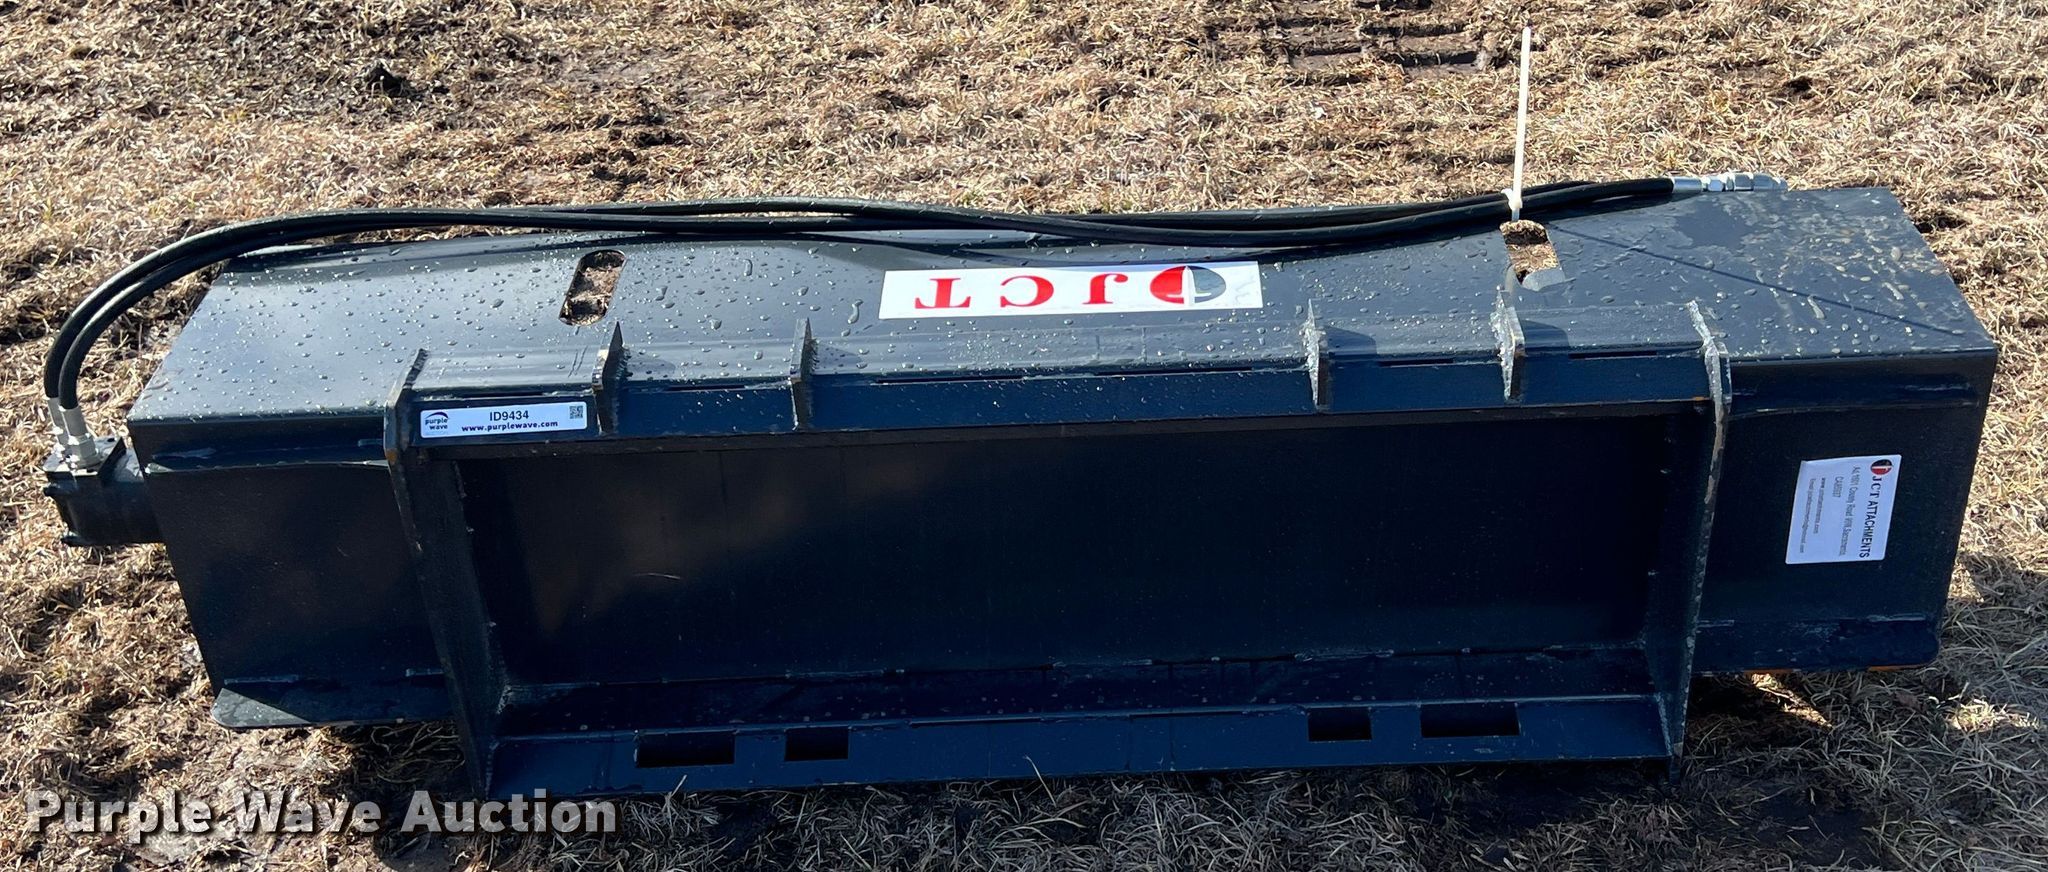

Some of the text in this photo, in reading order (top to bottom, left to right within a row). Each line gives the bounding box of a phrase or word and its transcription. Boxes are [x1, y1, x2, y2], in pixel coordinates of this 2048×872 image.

[915, 273, 1128, 309] JCT
[425, 417, 448, 425] purple
[489, 410, 530, 421] ID9434
[461, 420, 559, 432] www.purplewave.com
[1859, 475, 1882, 558] JCT ATTACHMENTS
